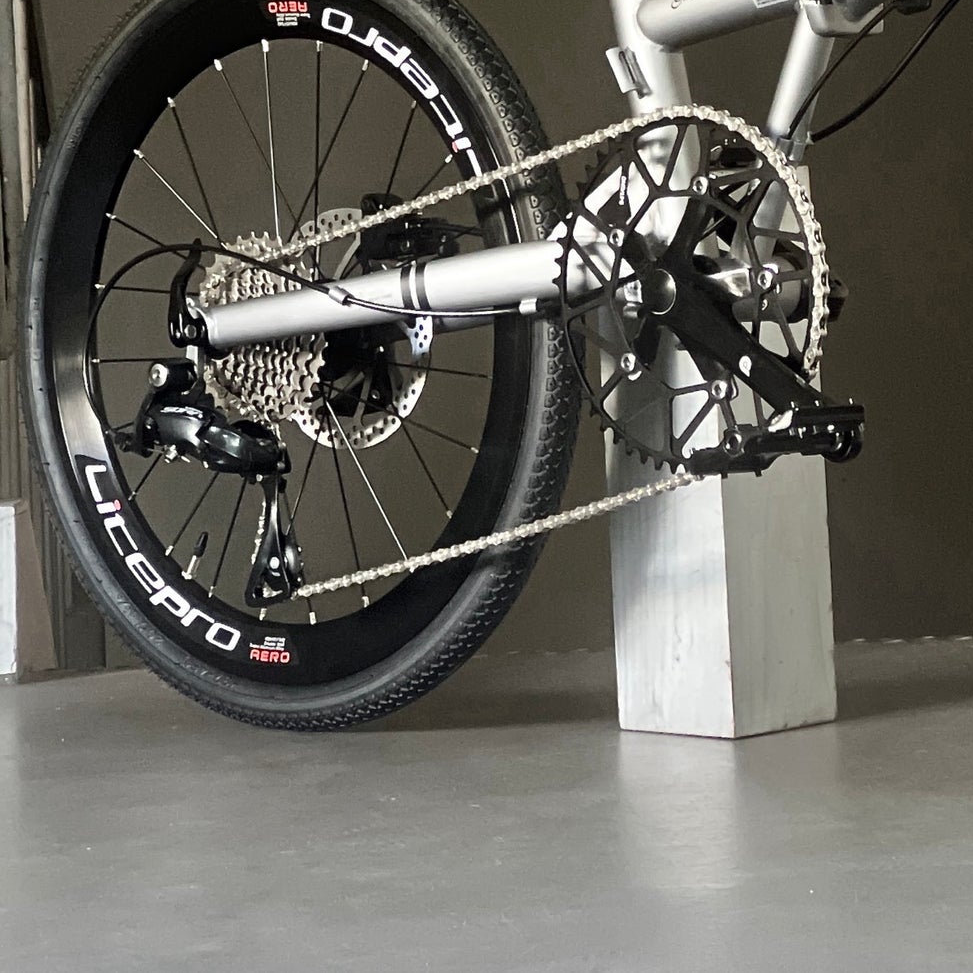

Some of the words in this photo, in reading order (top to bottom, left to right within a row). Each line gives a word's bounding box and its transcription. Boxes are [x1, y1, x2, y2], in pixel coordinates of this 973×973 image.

[267, 0, 309, 14] AERO
[85, 464, 242, 651] Litepro
[249, 648, 291, 664] AERO
